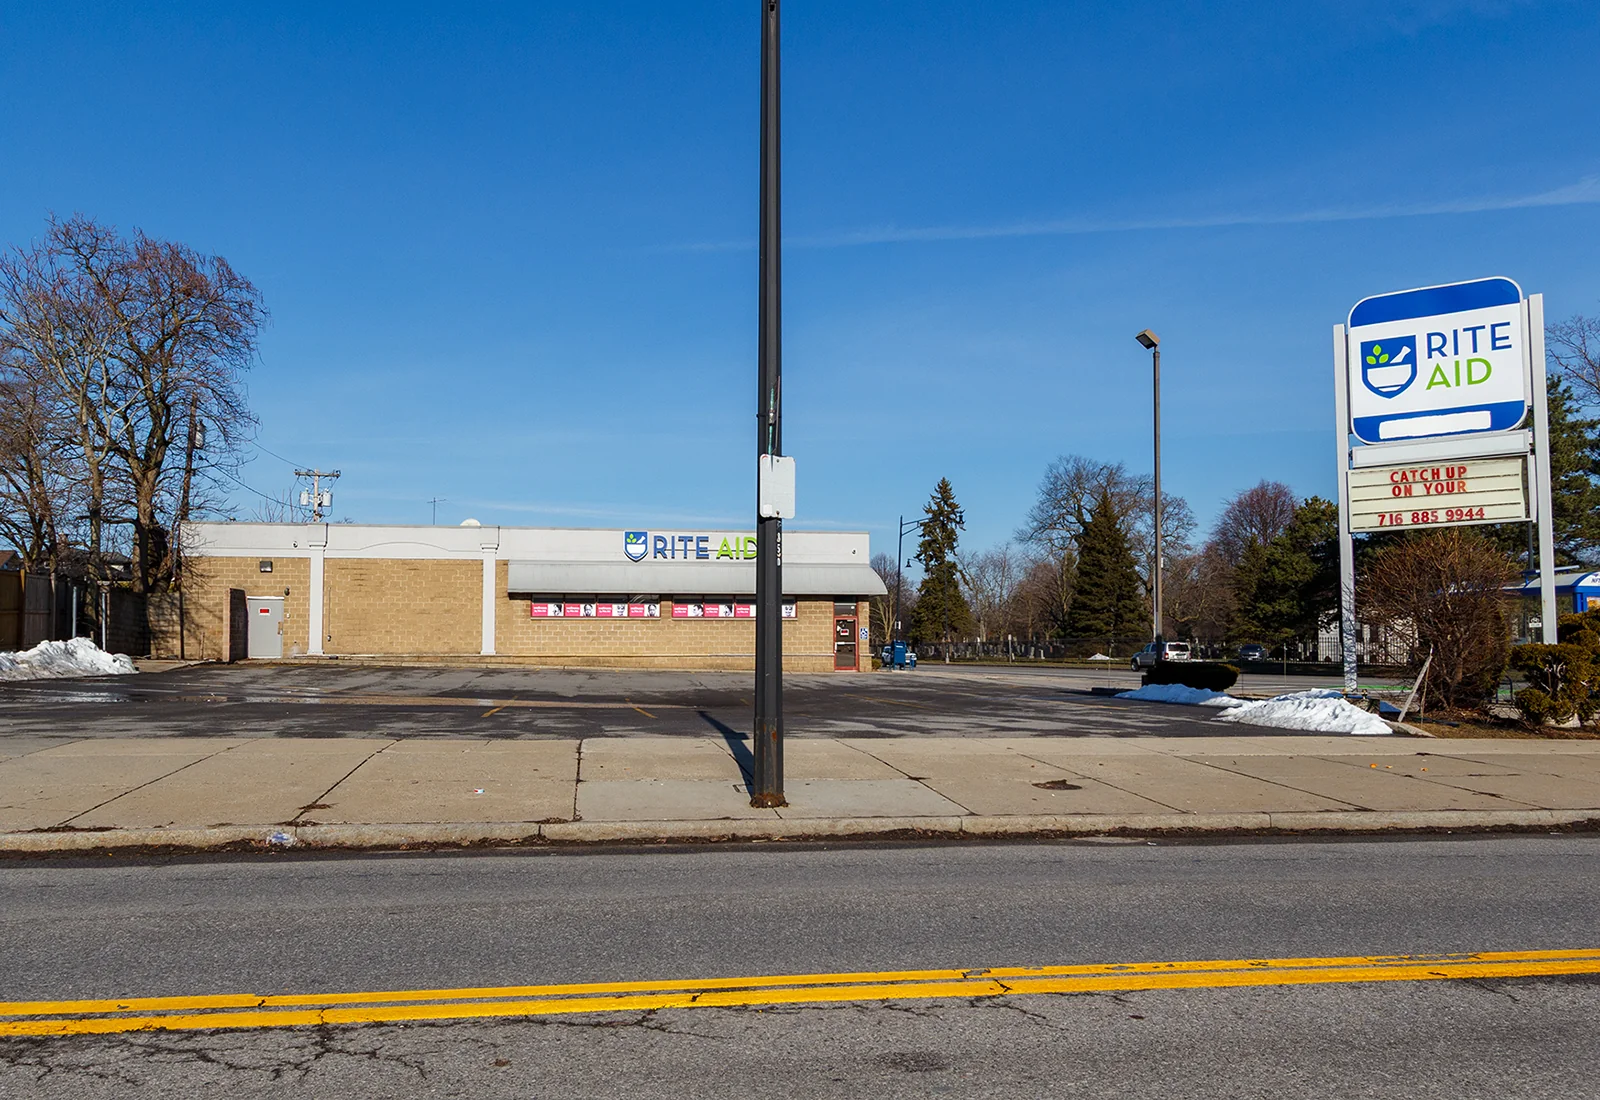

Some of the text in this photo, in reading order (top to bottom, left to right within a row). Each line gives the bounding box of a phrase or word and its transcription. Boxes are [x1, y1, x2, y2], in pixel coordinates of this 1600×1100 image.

[1426, 321, 1512, 359] RITE
[1426, 357, 1492, 390] AID
[1390, 465, 1467, 483] CATCH UP
[1392, 480, 1466, 497] ON YOUR
[1378, 507, 1485, 526] 716 885 9944
[653, 535, 709, 559] RITE
[716, 536, 757, 559] AID
